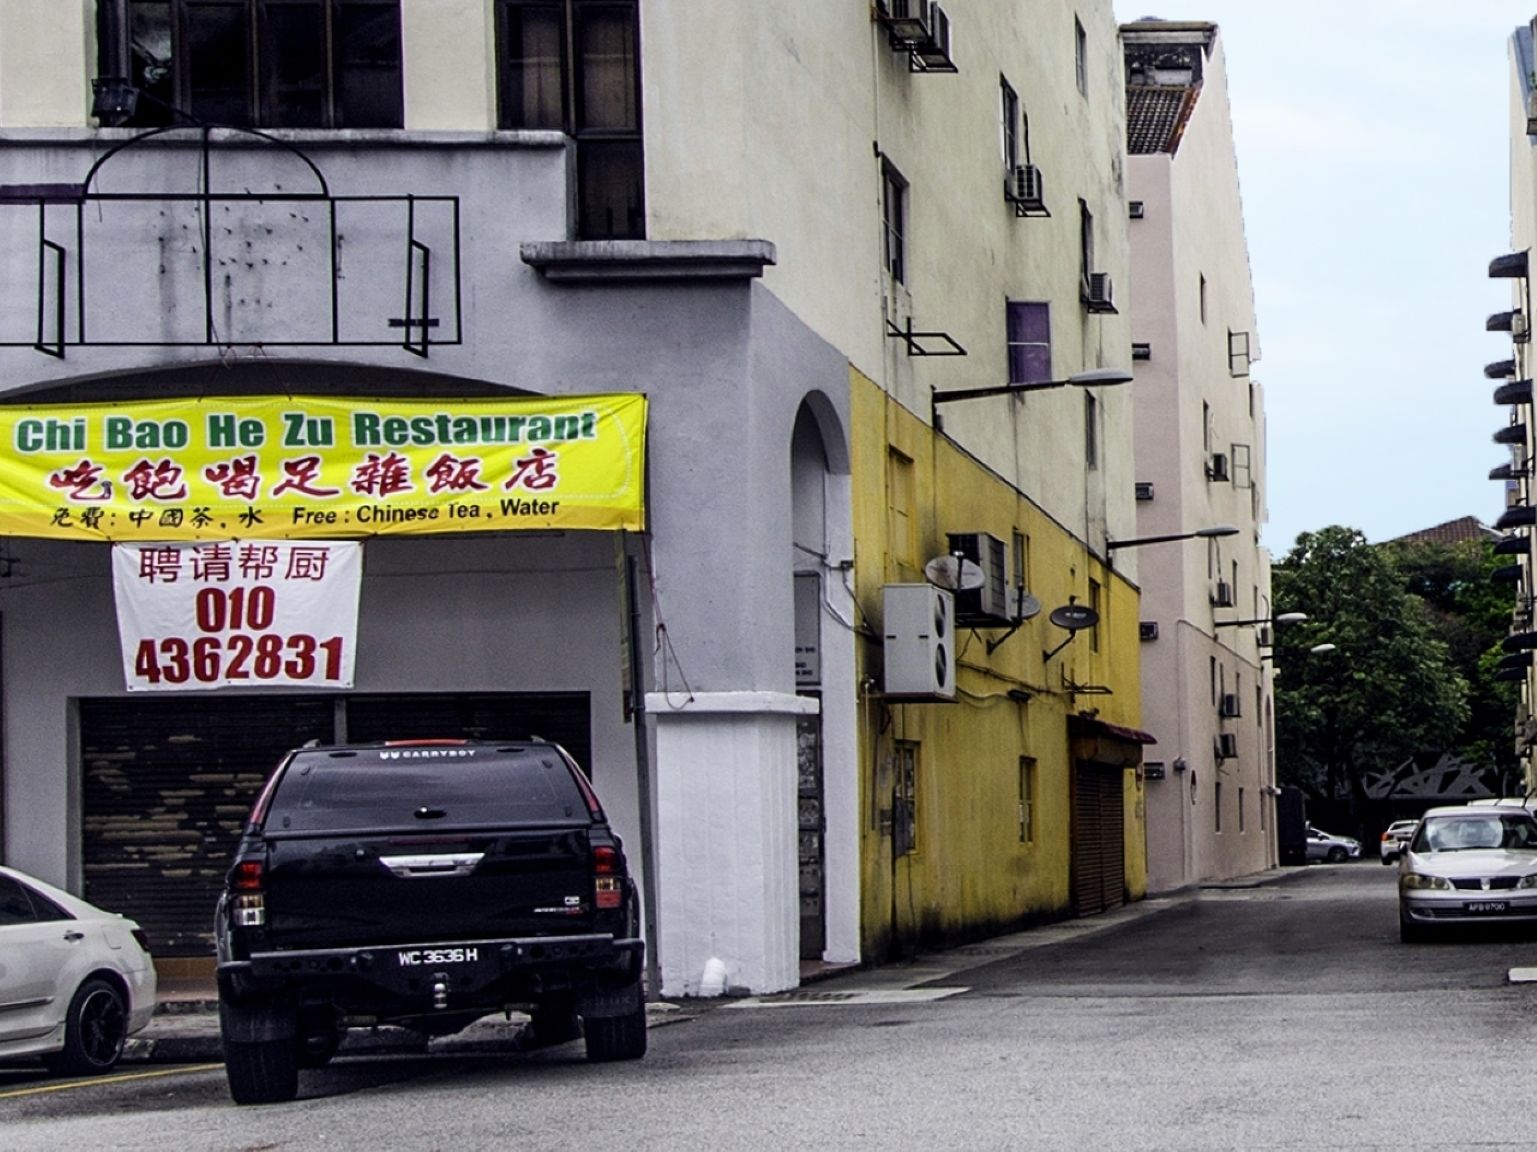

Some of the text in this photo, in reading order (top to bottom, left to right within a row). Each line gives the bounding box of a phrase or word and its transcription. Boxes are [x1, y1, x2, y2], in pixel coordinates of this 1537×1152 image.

[17, 411, 598, 452] Chi Bao He Zu Restaurant
[293, 507, 337, 525] Free
[356, 504, 440, 523] Chinese
[448, 503, 480, 518] Tea
[500, 499, 560, 517] Water
[139, 544, 331, 584] 聘请帮厨
[196, 586, 276, 633] 010
[135, 634, 343, 684] 4362831
[398, 947, 479, 967] WC 3636 H
